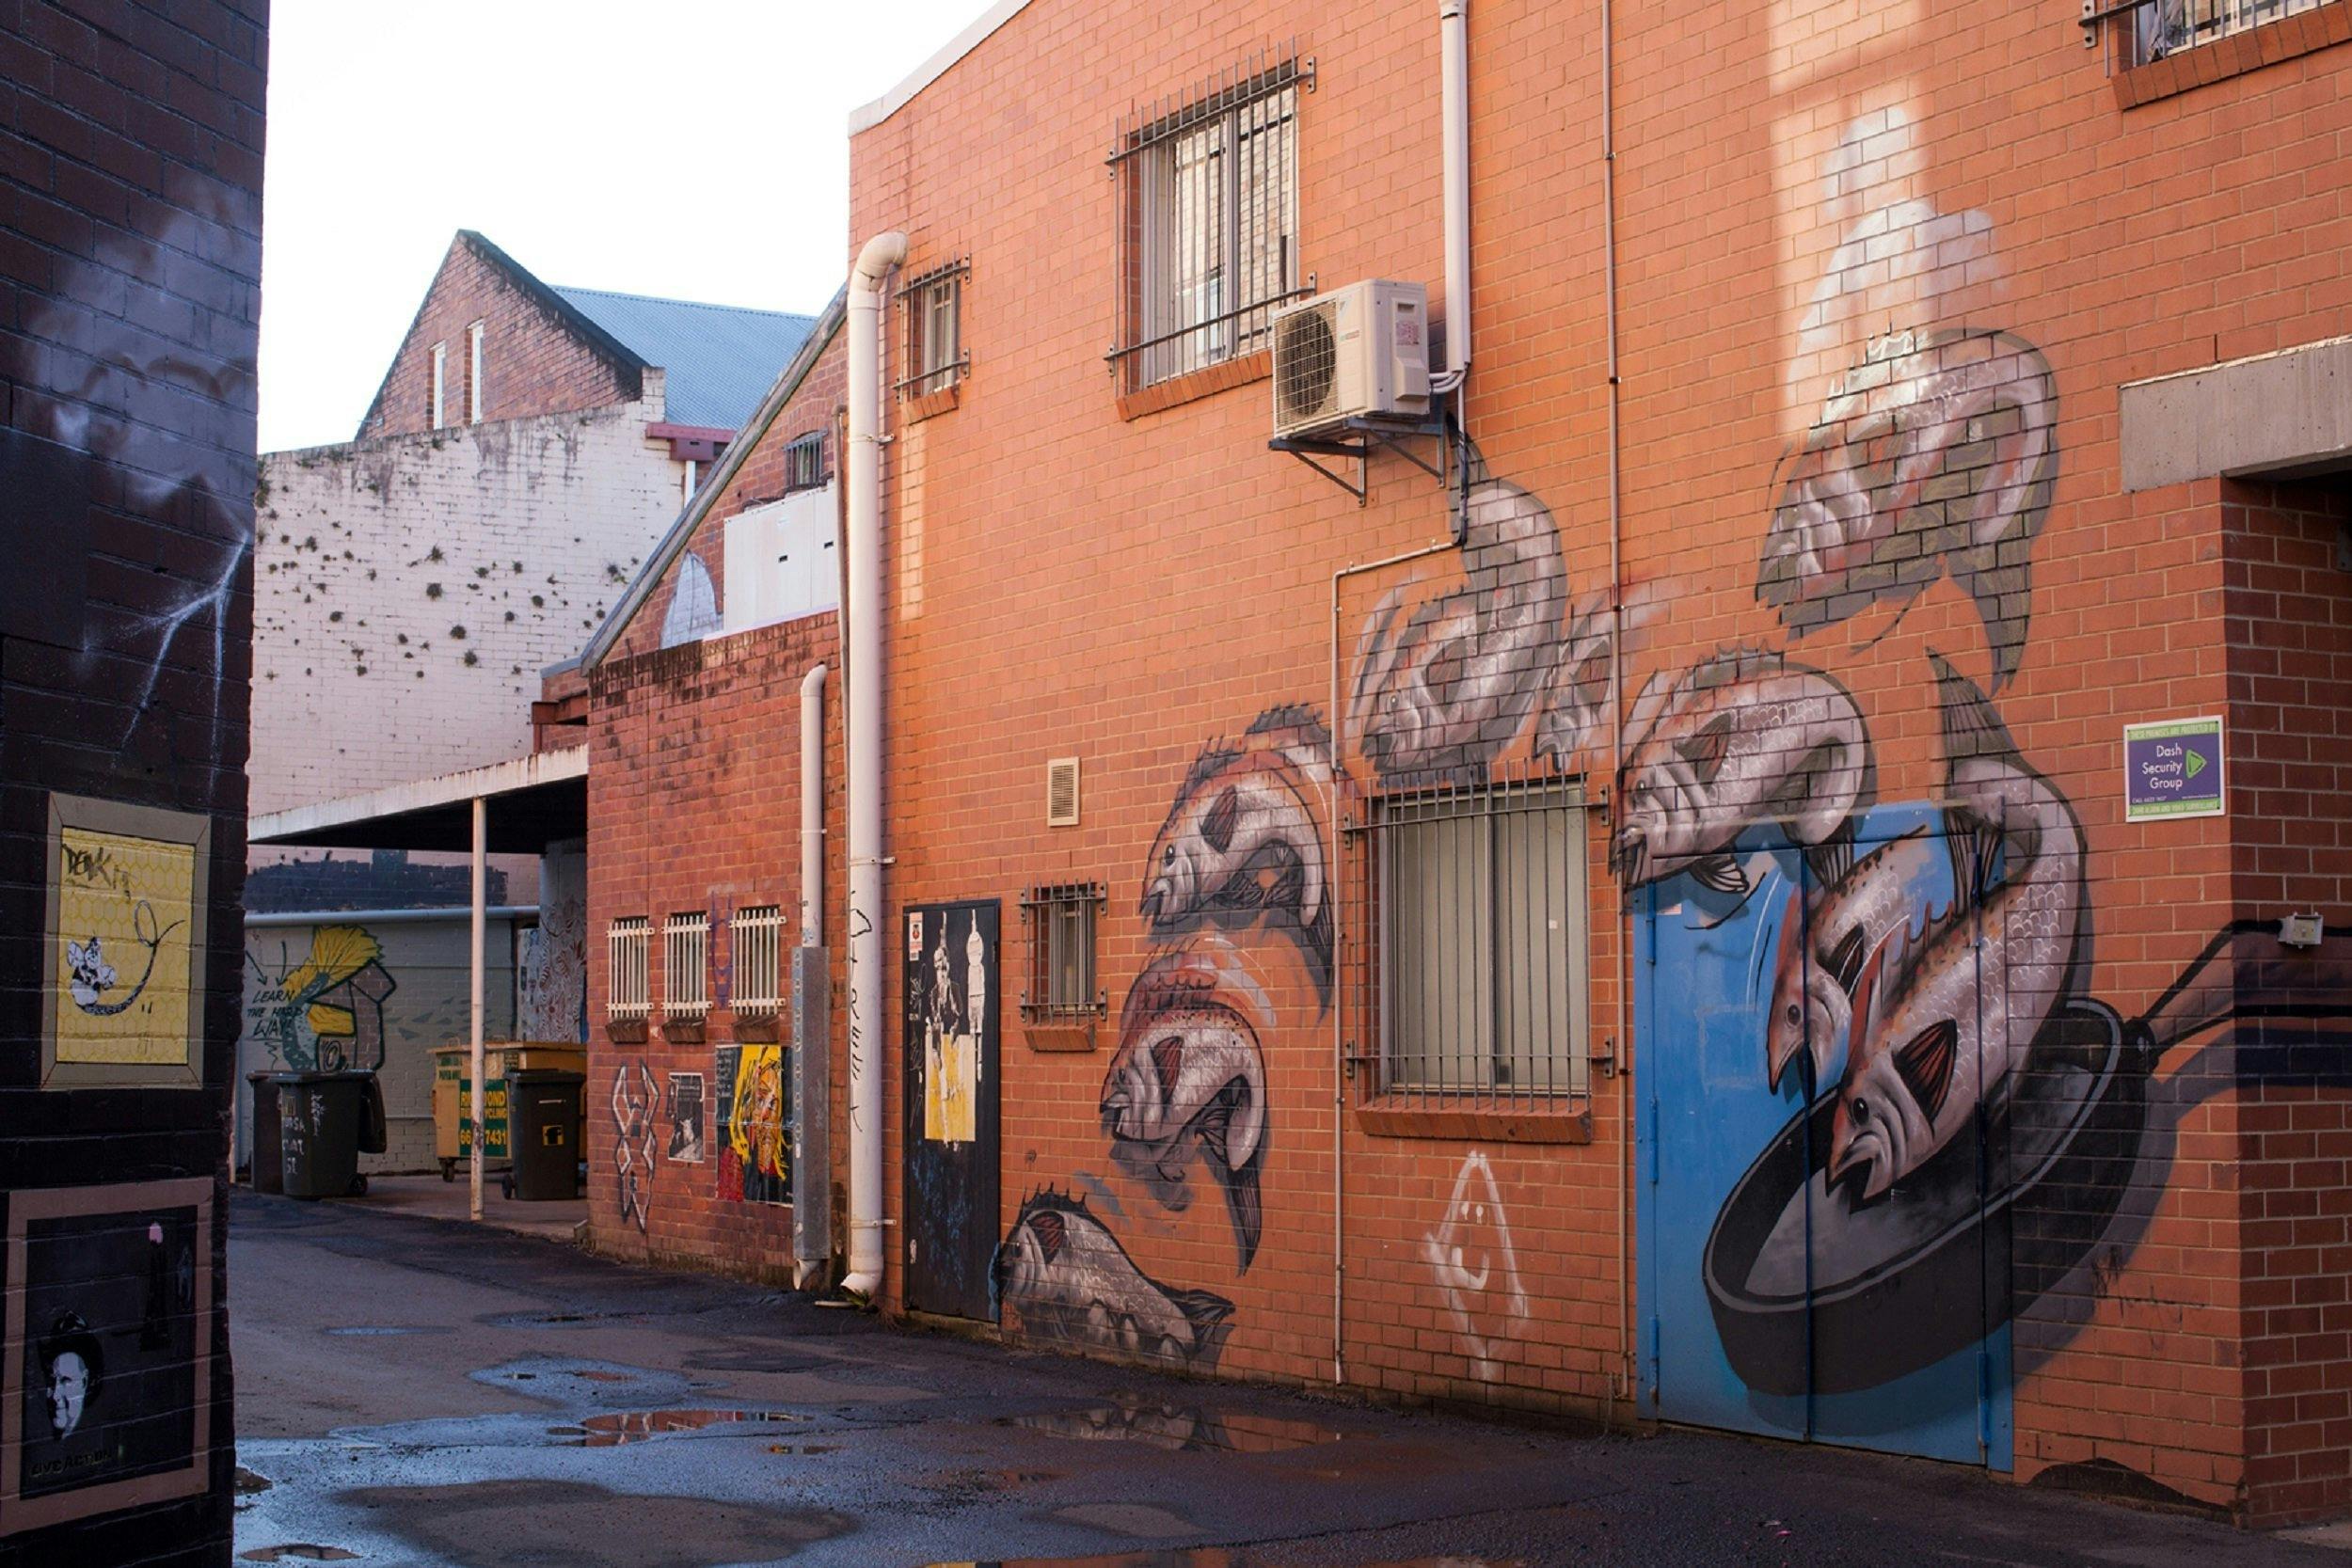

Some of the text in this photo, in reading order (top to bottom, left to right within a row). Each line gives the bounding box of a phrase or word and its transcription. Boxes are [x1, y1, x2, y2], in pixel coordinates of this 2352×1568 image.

[2156, 742, 2182, 757] Dash
[2141, 760, 2183, 775] Security
[2150, 777, 2183, 790] Group
[252, 990, 295, 1004] LEARN
[246, 1006, 267, 1018] THE
